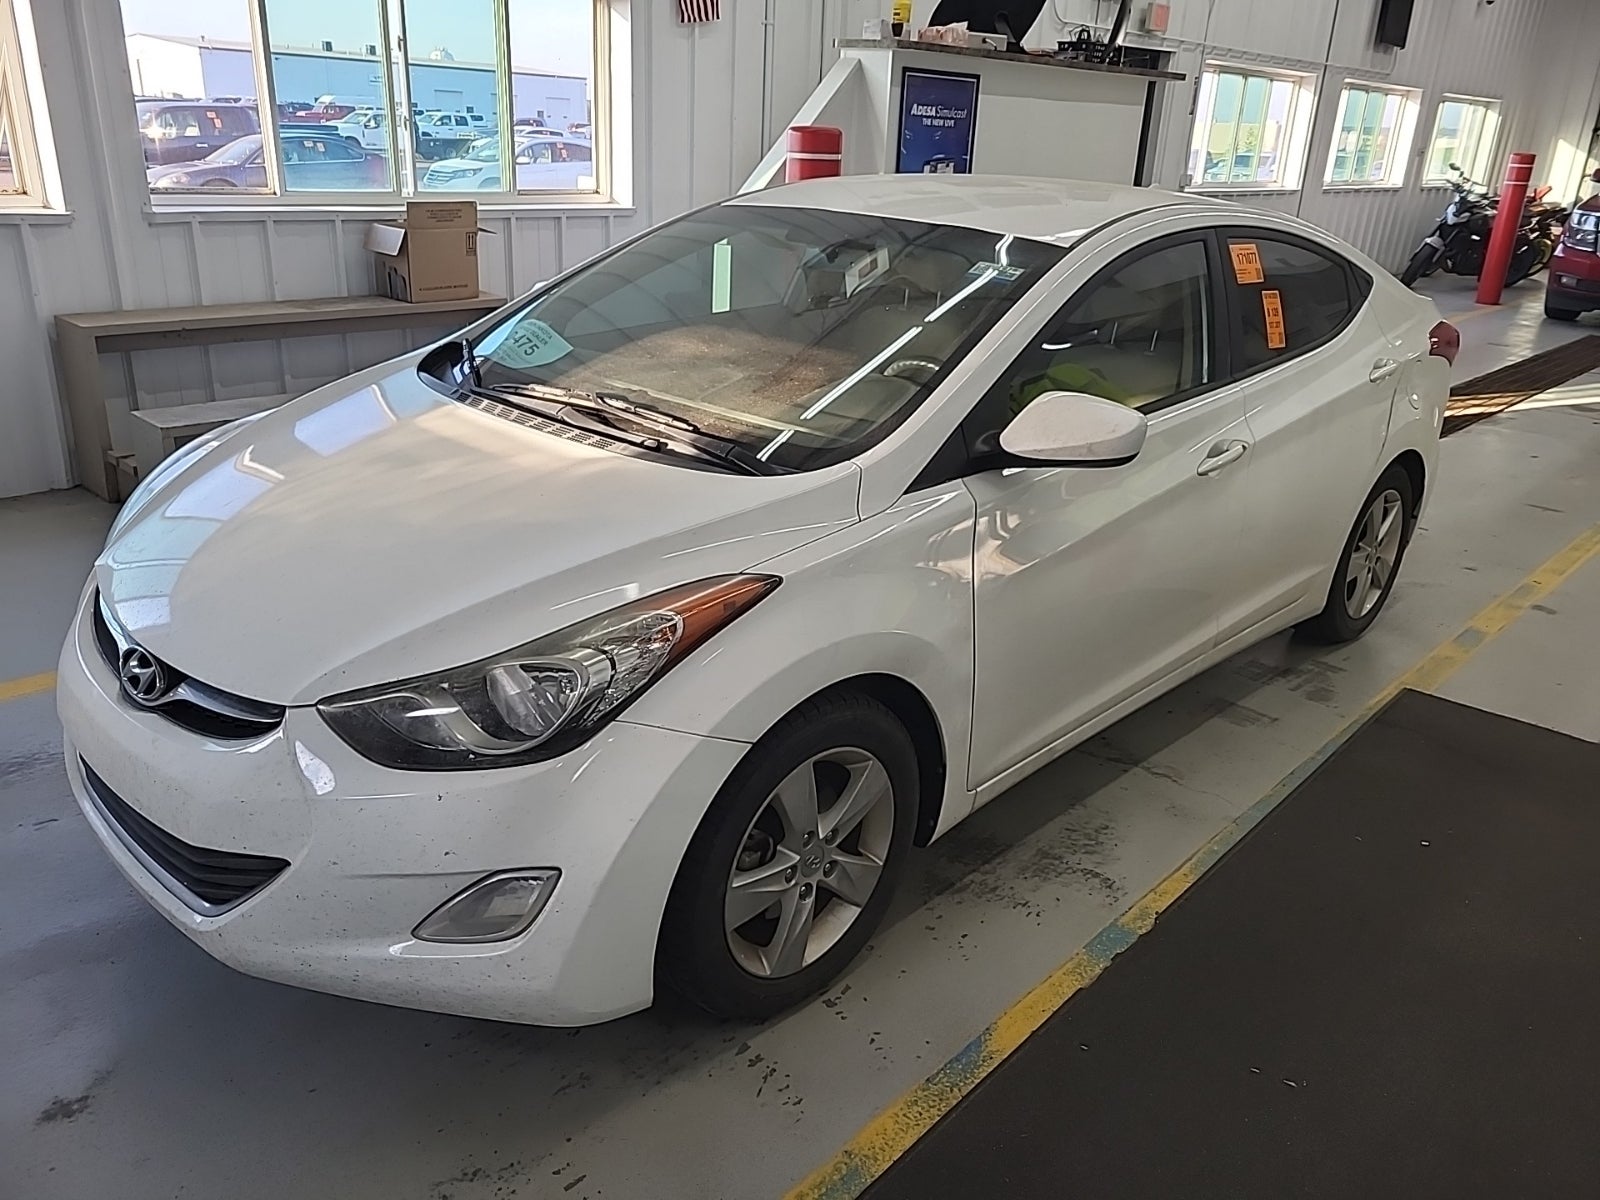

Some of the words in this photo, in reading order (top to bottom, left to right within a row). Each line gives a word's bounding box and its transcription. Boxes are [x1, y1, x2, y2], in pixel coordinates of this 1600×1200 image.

[911, 103, 936, 117] ADESA
[936, 105, 967, 119] Simulcast
[922, 118, 931, 126] THE
[932, 118, 944, 127] NEW
[512, 331, 540, 356] 475
